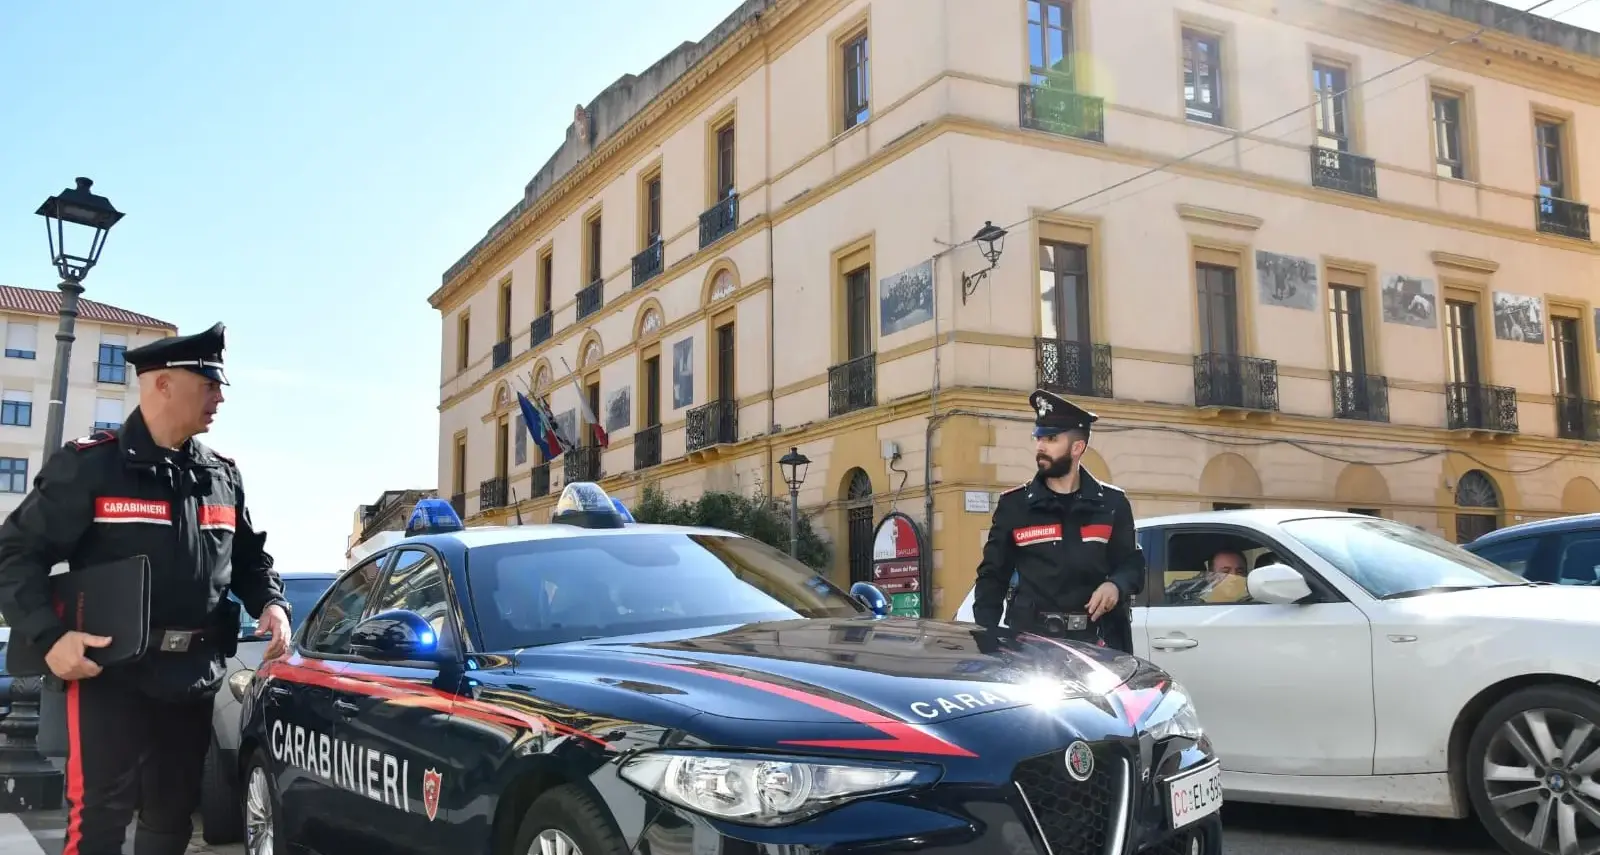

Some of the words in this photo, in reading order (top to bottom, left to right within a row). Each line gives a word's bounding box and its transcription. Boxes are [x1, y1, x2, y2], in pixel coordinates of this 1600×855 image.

[103, 502, 167, 515] CARABINIERI
[1016, 527, 1056, 540] CARABINIERI
[272, 719, 410, 813] CARABINIERI
